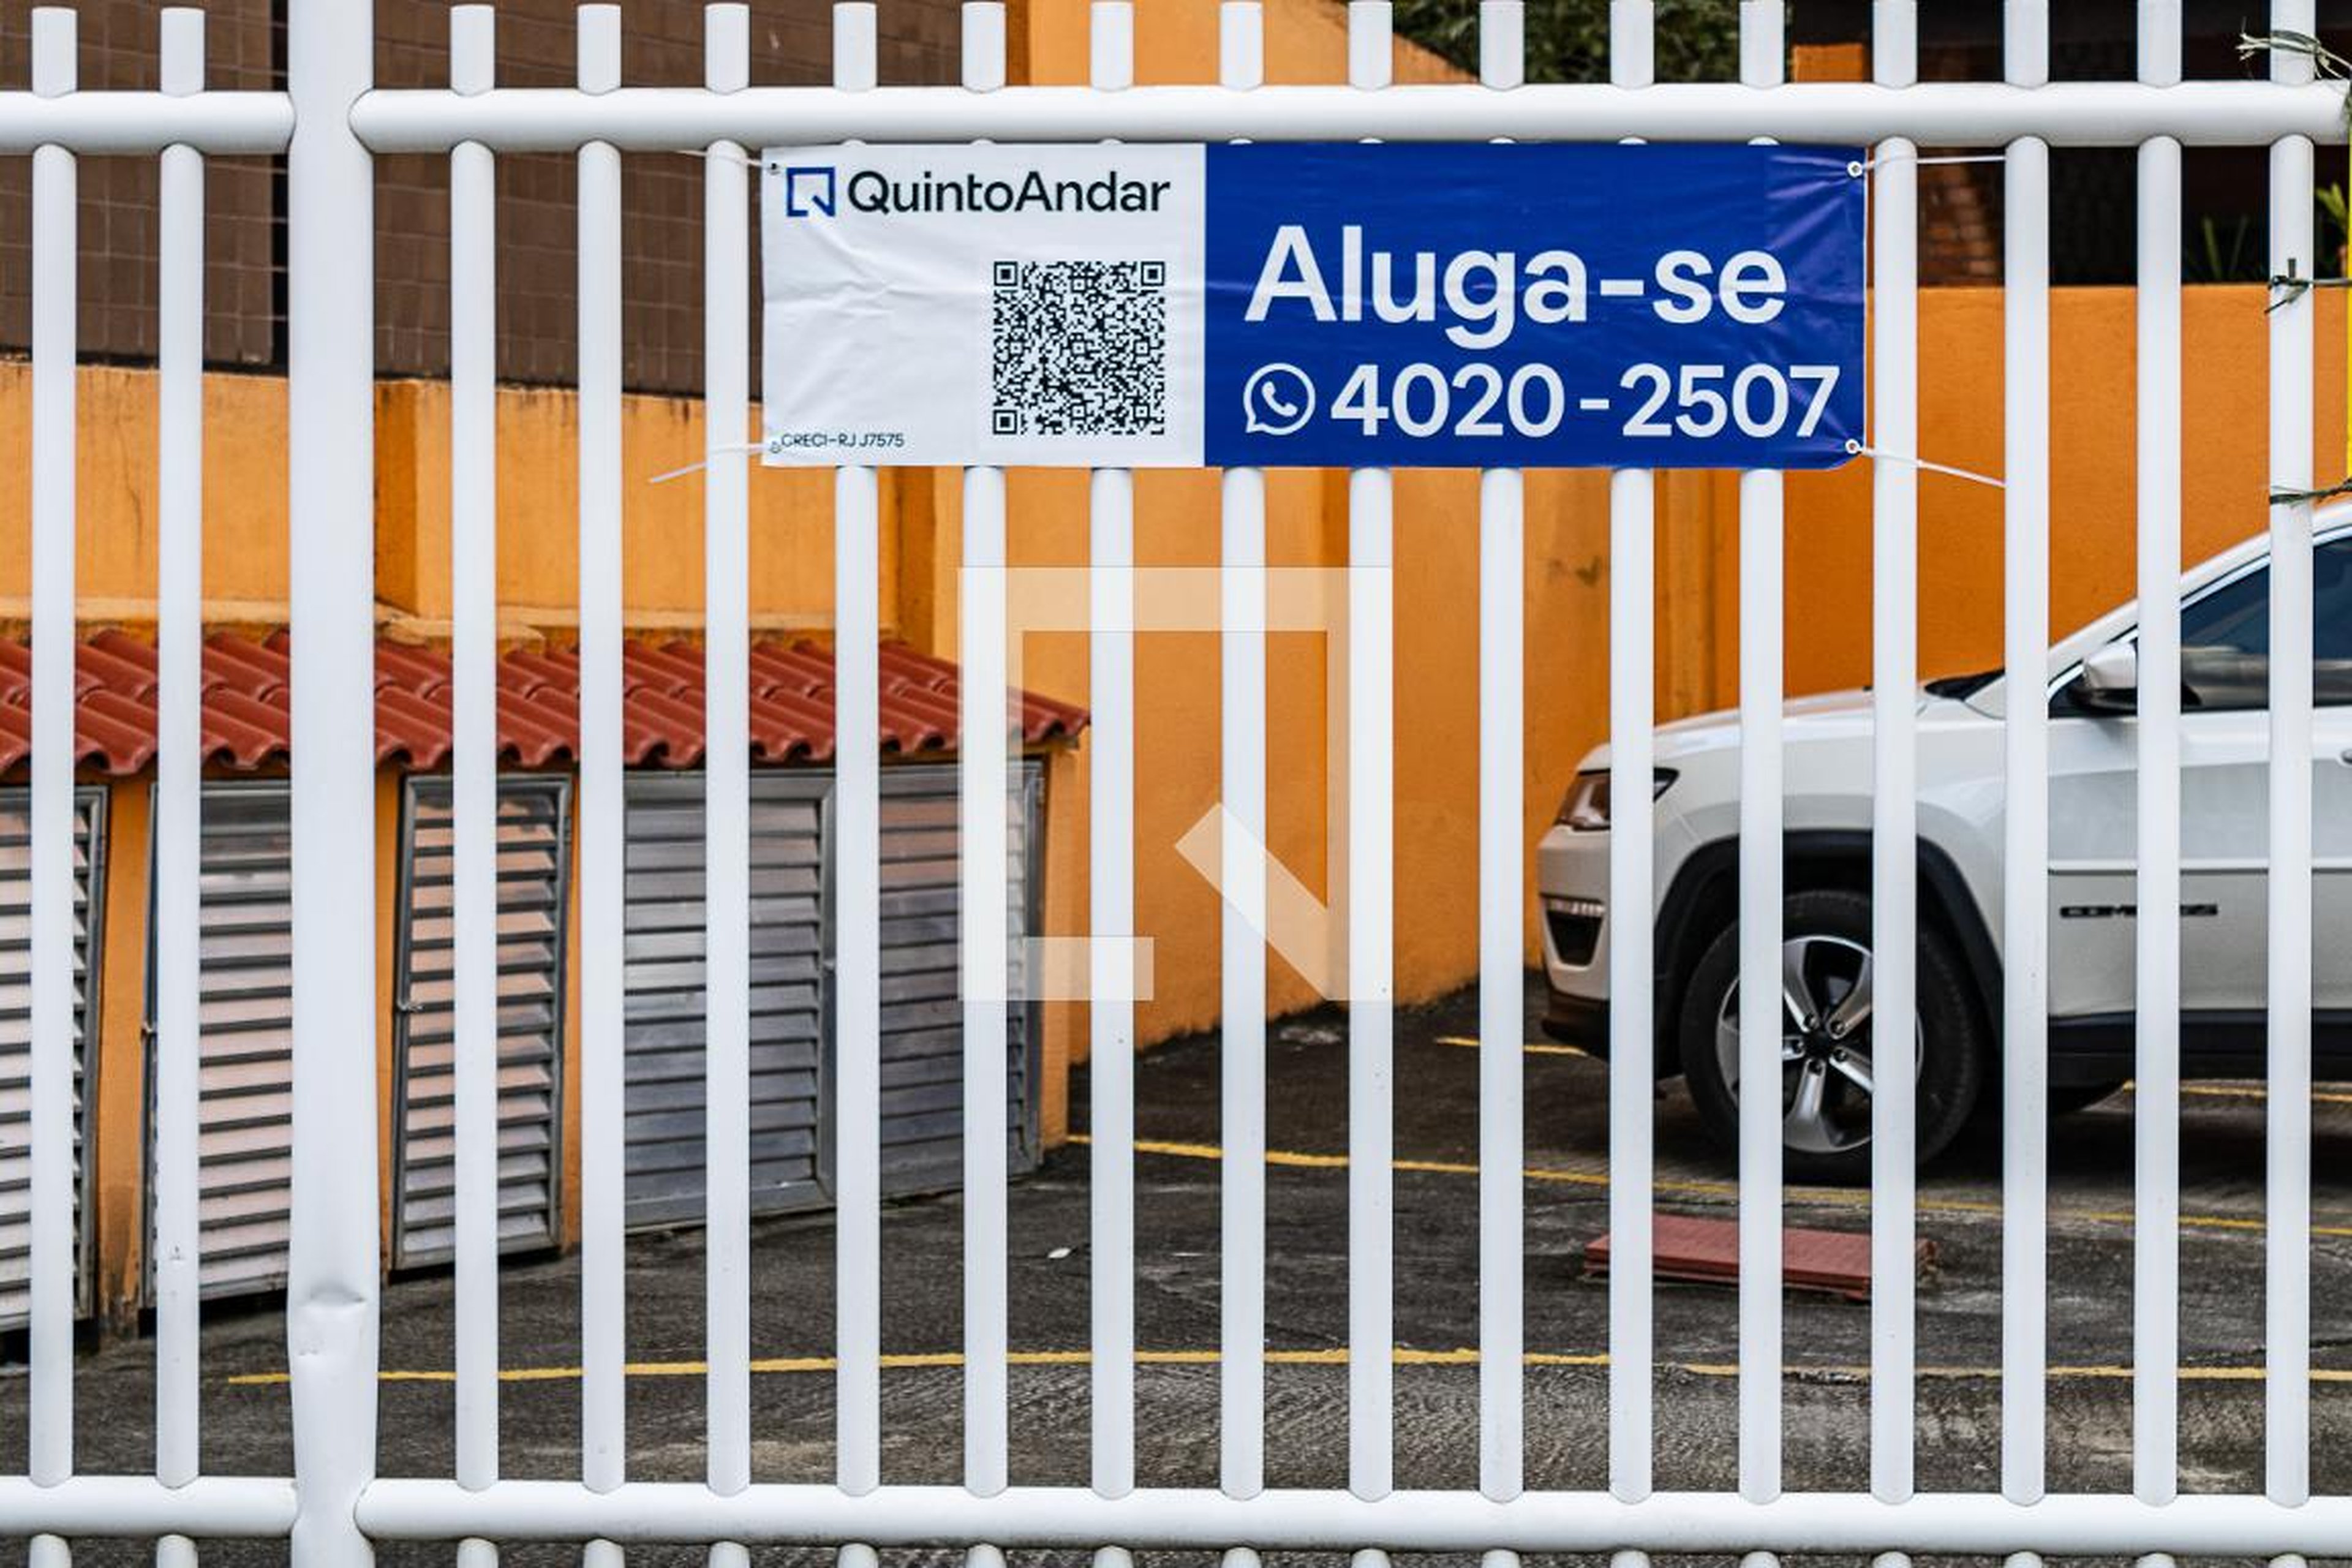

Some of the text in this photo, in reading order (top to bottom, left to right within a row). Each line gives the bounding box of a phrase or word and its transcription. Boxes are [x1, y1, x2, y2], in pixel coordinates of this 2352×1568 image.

[846, 170, 1171, 215] QuintoAndar
[1243, 225, 1788, 350] Aluga-se
[781, 432, 905, 448] CRECI-RJ J7575
